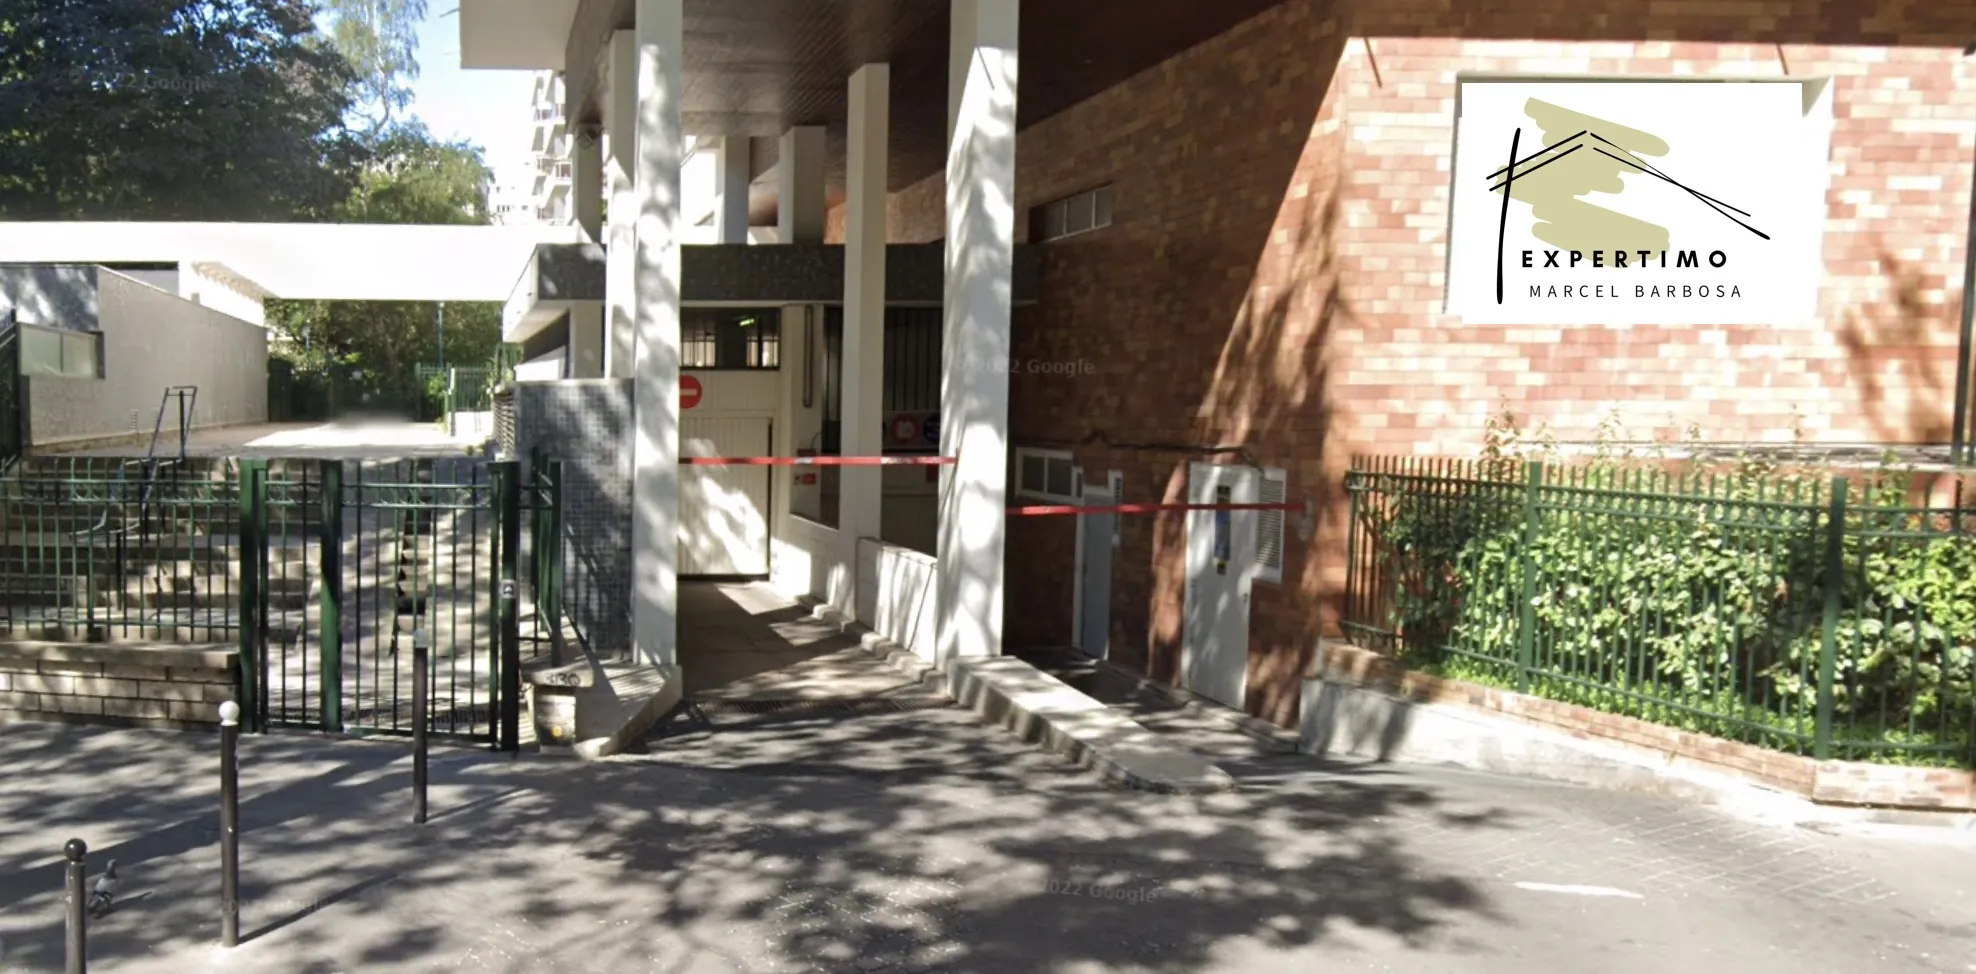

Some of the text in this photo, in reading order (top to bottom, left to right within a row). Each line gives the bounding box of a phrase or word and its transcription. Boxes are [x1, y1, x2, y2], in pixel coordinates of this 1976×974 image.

[1522, 250, 1727, 268] EXPERTIMO
[1530, 285, 1741, 298] MARCEL BARBOSA
